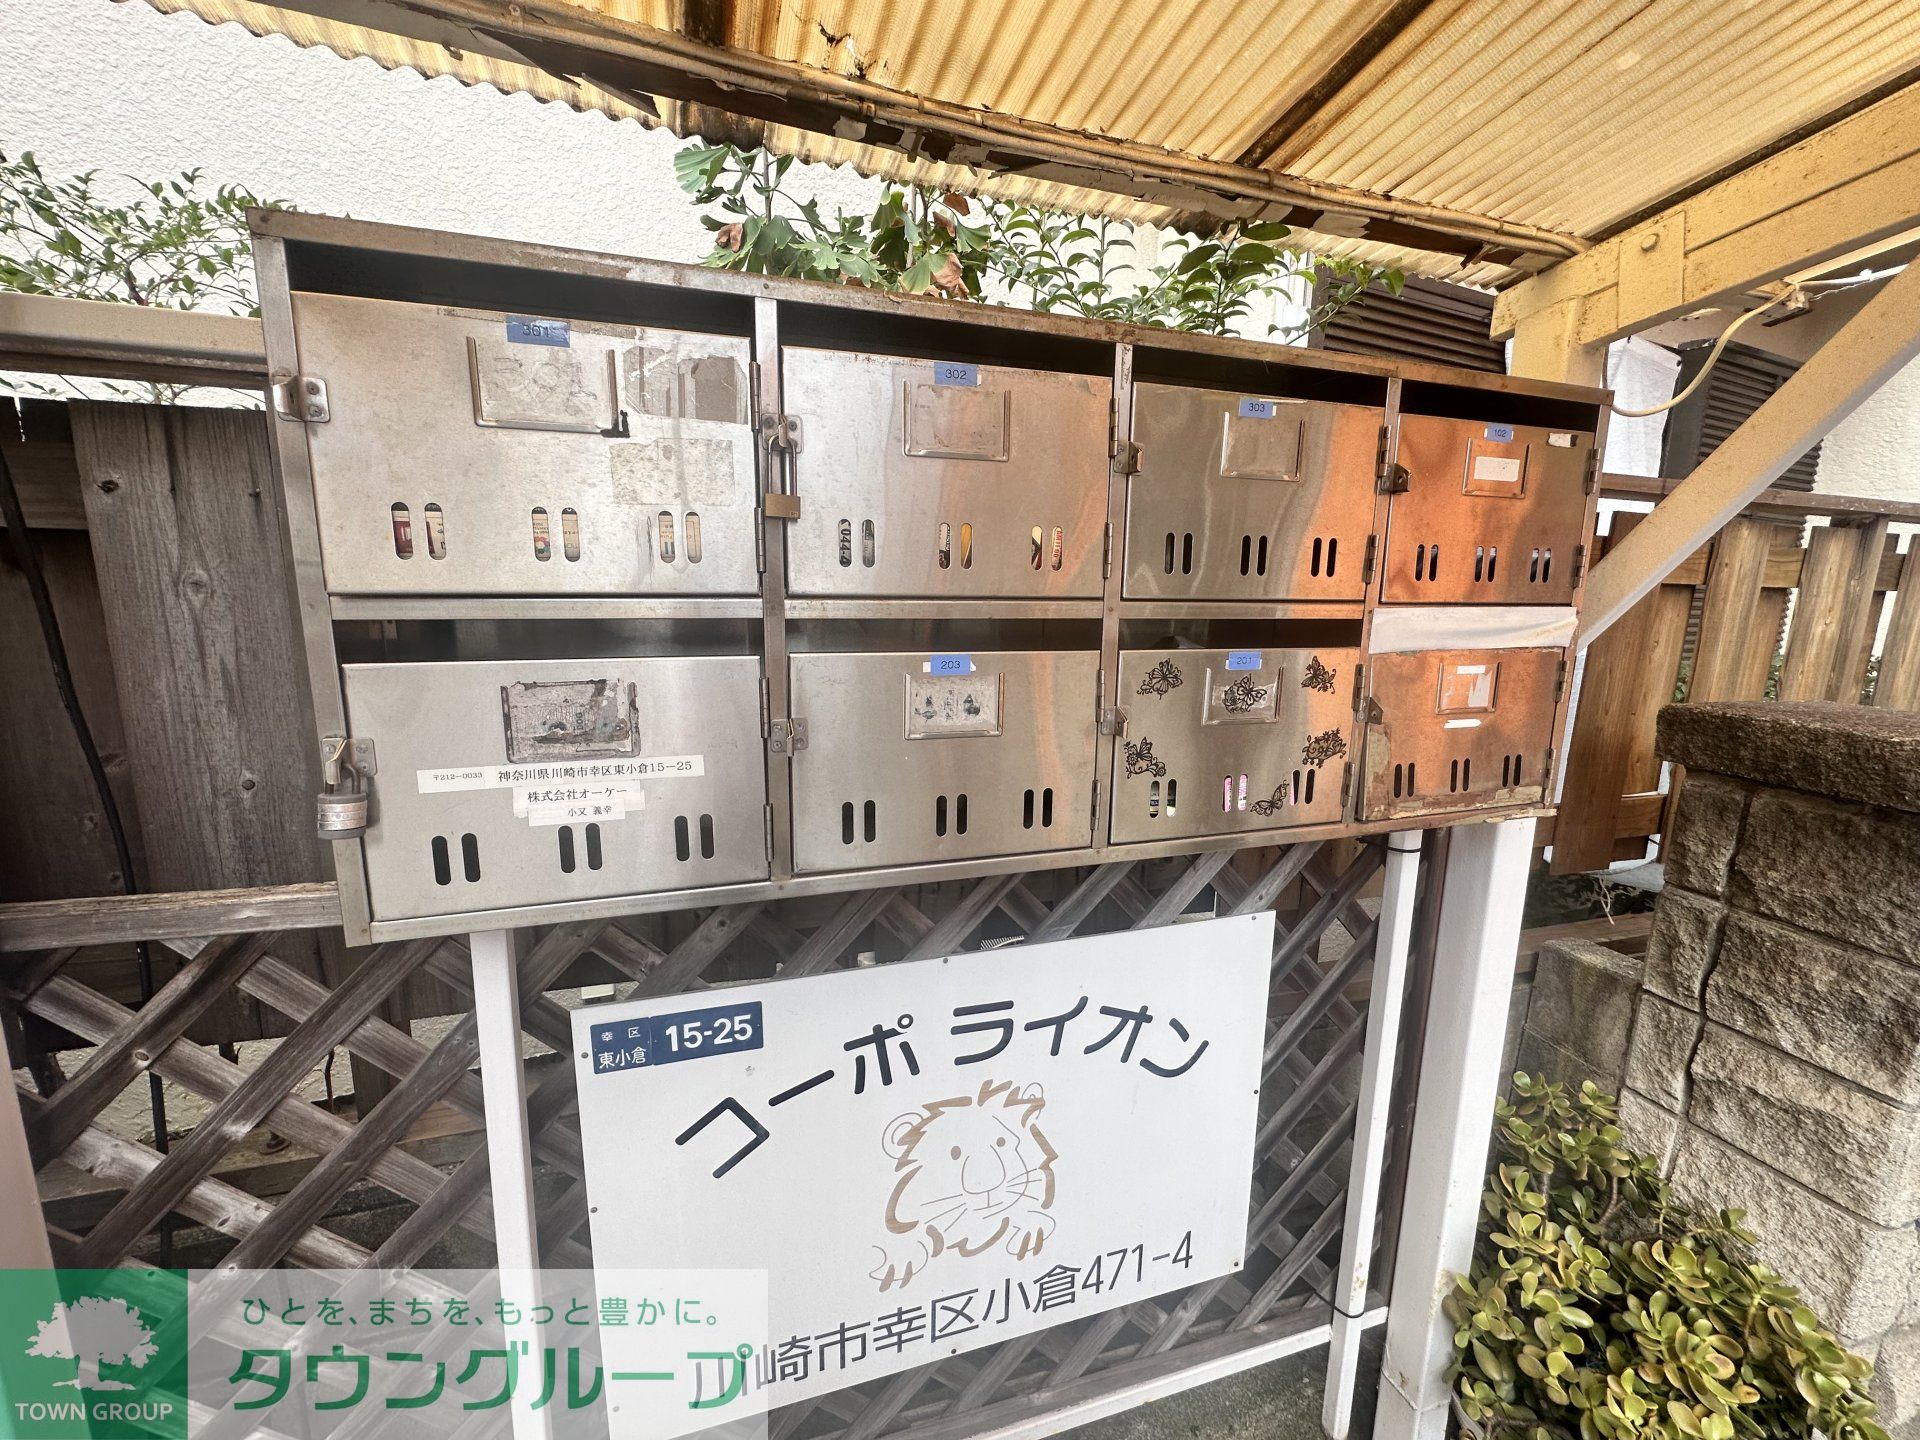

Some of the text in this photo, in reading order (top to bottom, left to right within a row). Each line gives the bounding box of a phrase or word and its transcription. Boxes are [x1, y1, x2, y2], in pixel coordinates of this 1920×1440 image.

[522, 324, 549, 337] 301
[945, 368, 967, 380] 302
[1248, 402, 1265, 412] 303
[1494, 428, 1507, 438] 102
[941, 660, 961, 669] 203
[1236, 656, 1252, 665] 201
[527, 786, 628, 803] 株式会社オーケー
[665, 1014, 753, 1052] 15-25
[598, 1046, 647, 1069] 東小倉
[674, 995, 1210, 1179] コーポ ライオン
